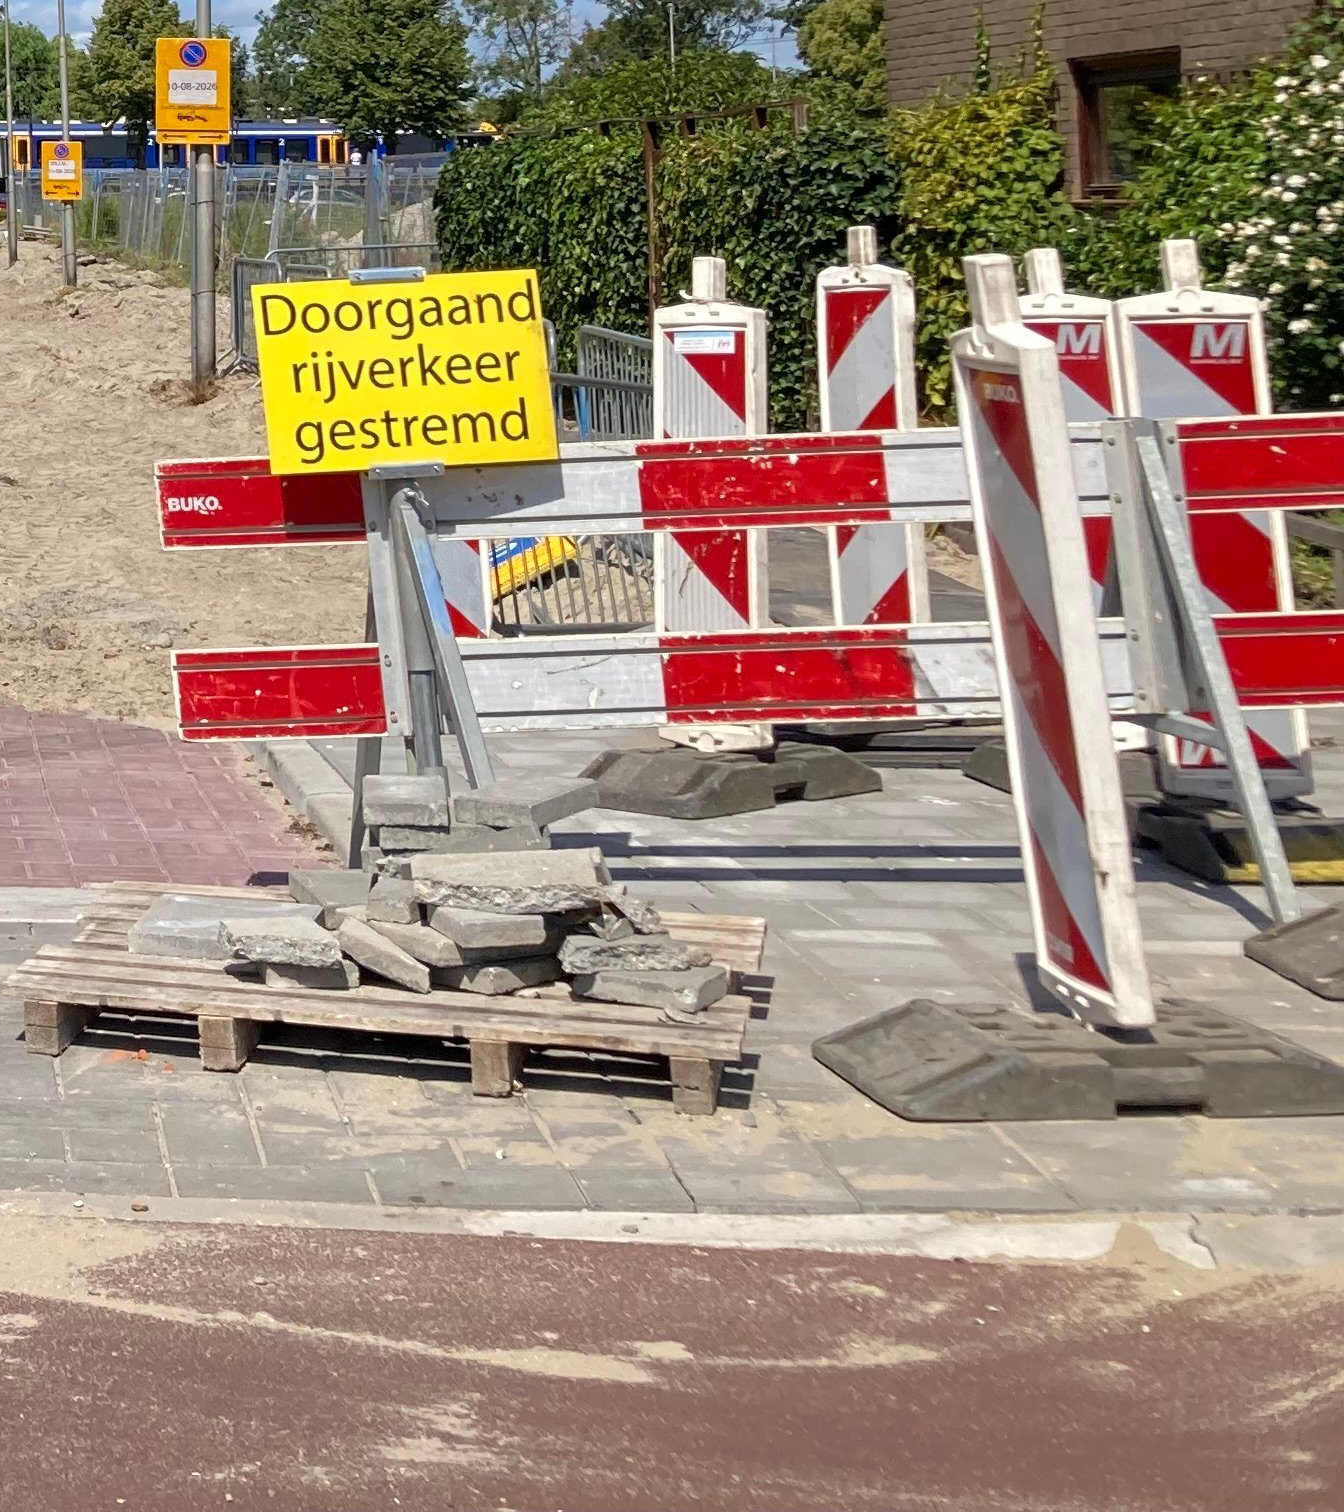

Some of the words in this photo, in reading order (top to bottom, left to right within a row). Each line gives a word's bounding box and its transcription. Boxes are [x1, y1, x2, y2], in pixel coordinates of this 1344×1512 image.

[278, 137, 285, 146] 2
[260, 278, 538, 340] Doorgaand
[1189, 323, 1245, 357] M
[291, 343, 521, 404] rijverkeer
[295, 397, 529, 465] gestremd
